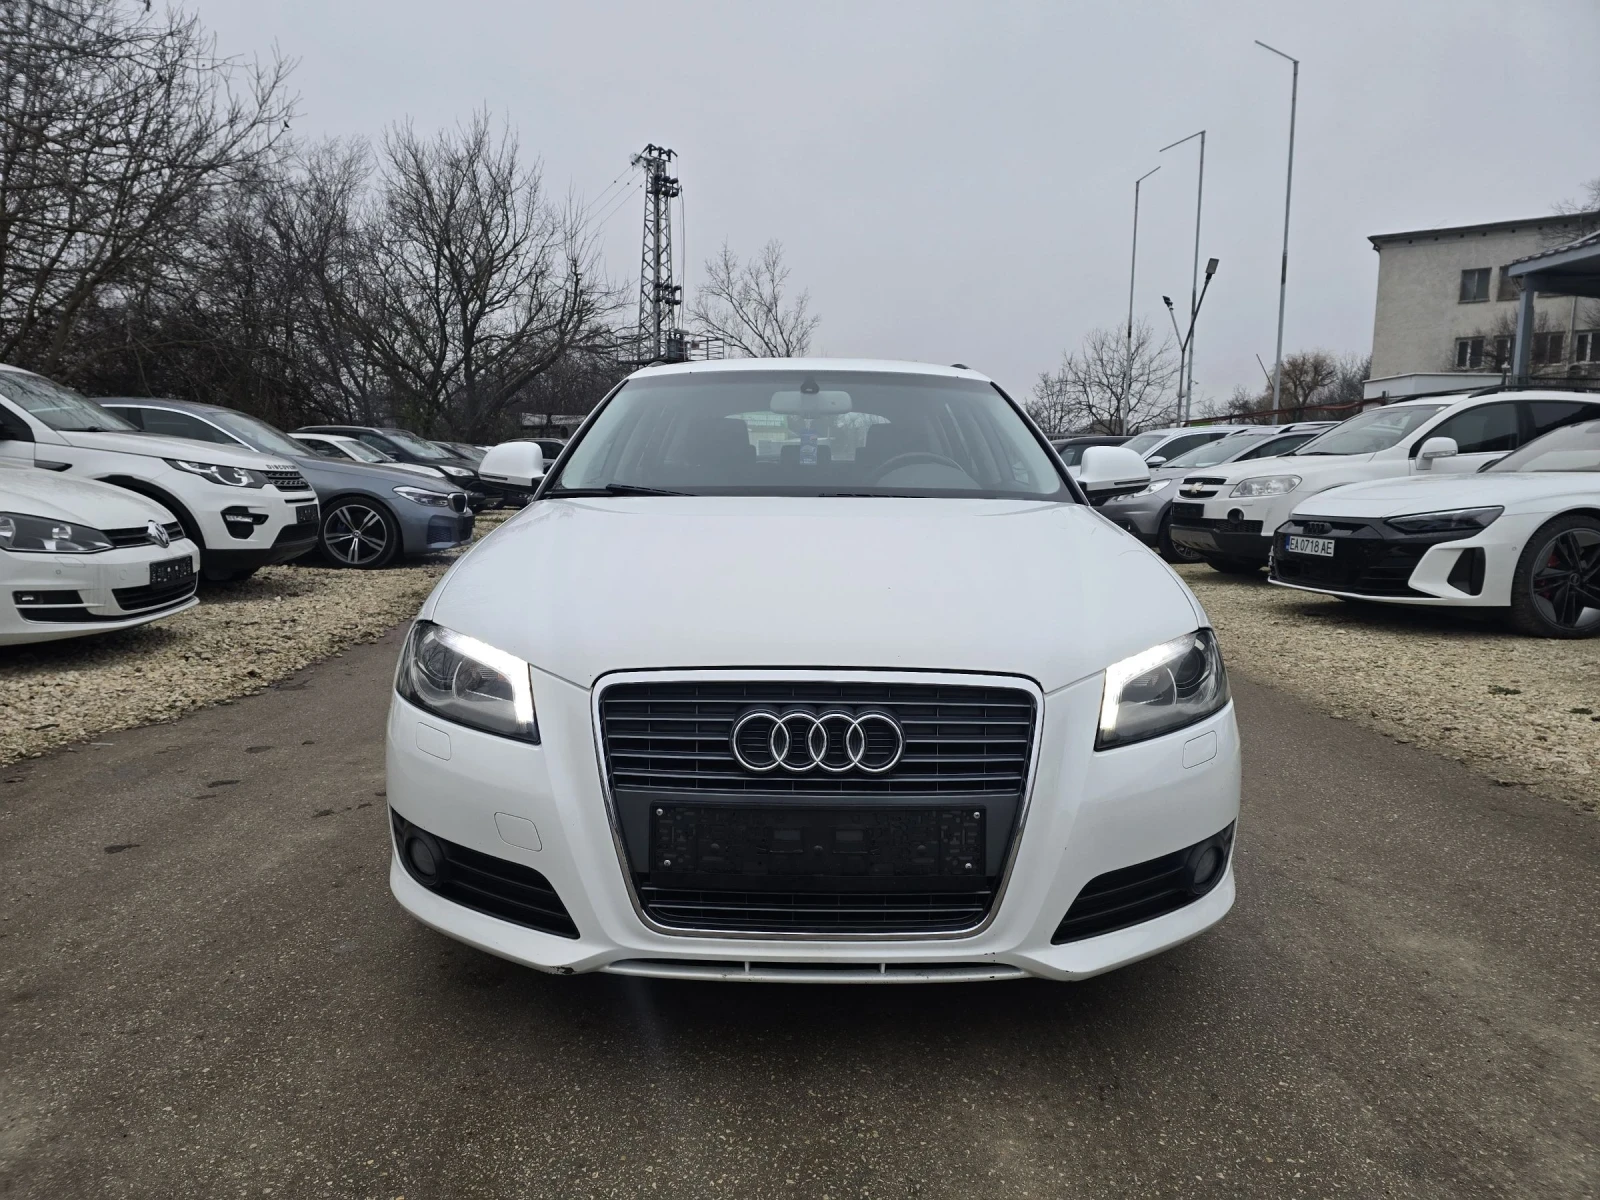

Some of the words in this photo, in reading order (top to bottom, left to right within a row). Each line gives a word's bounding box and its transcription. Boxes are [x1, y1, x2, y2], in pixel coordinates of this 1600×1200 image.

[1290, 538, 1299, 551] EA
[1300, 539, 1320, 553] 0718
[1320, 541, 1333, 555] AE
